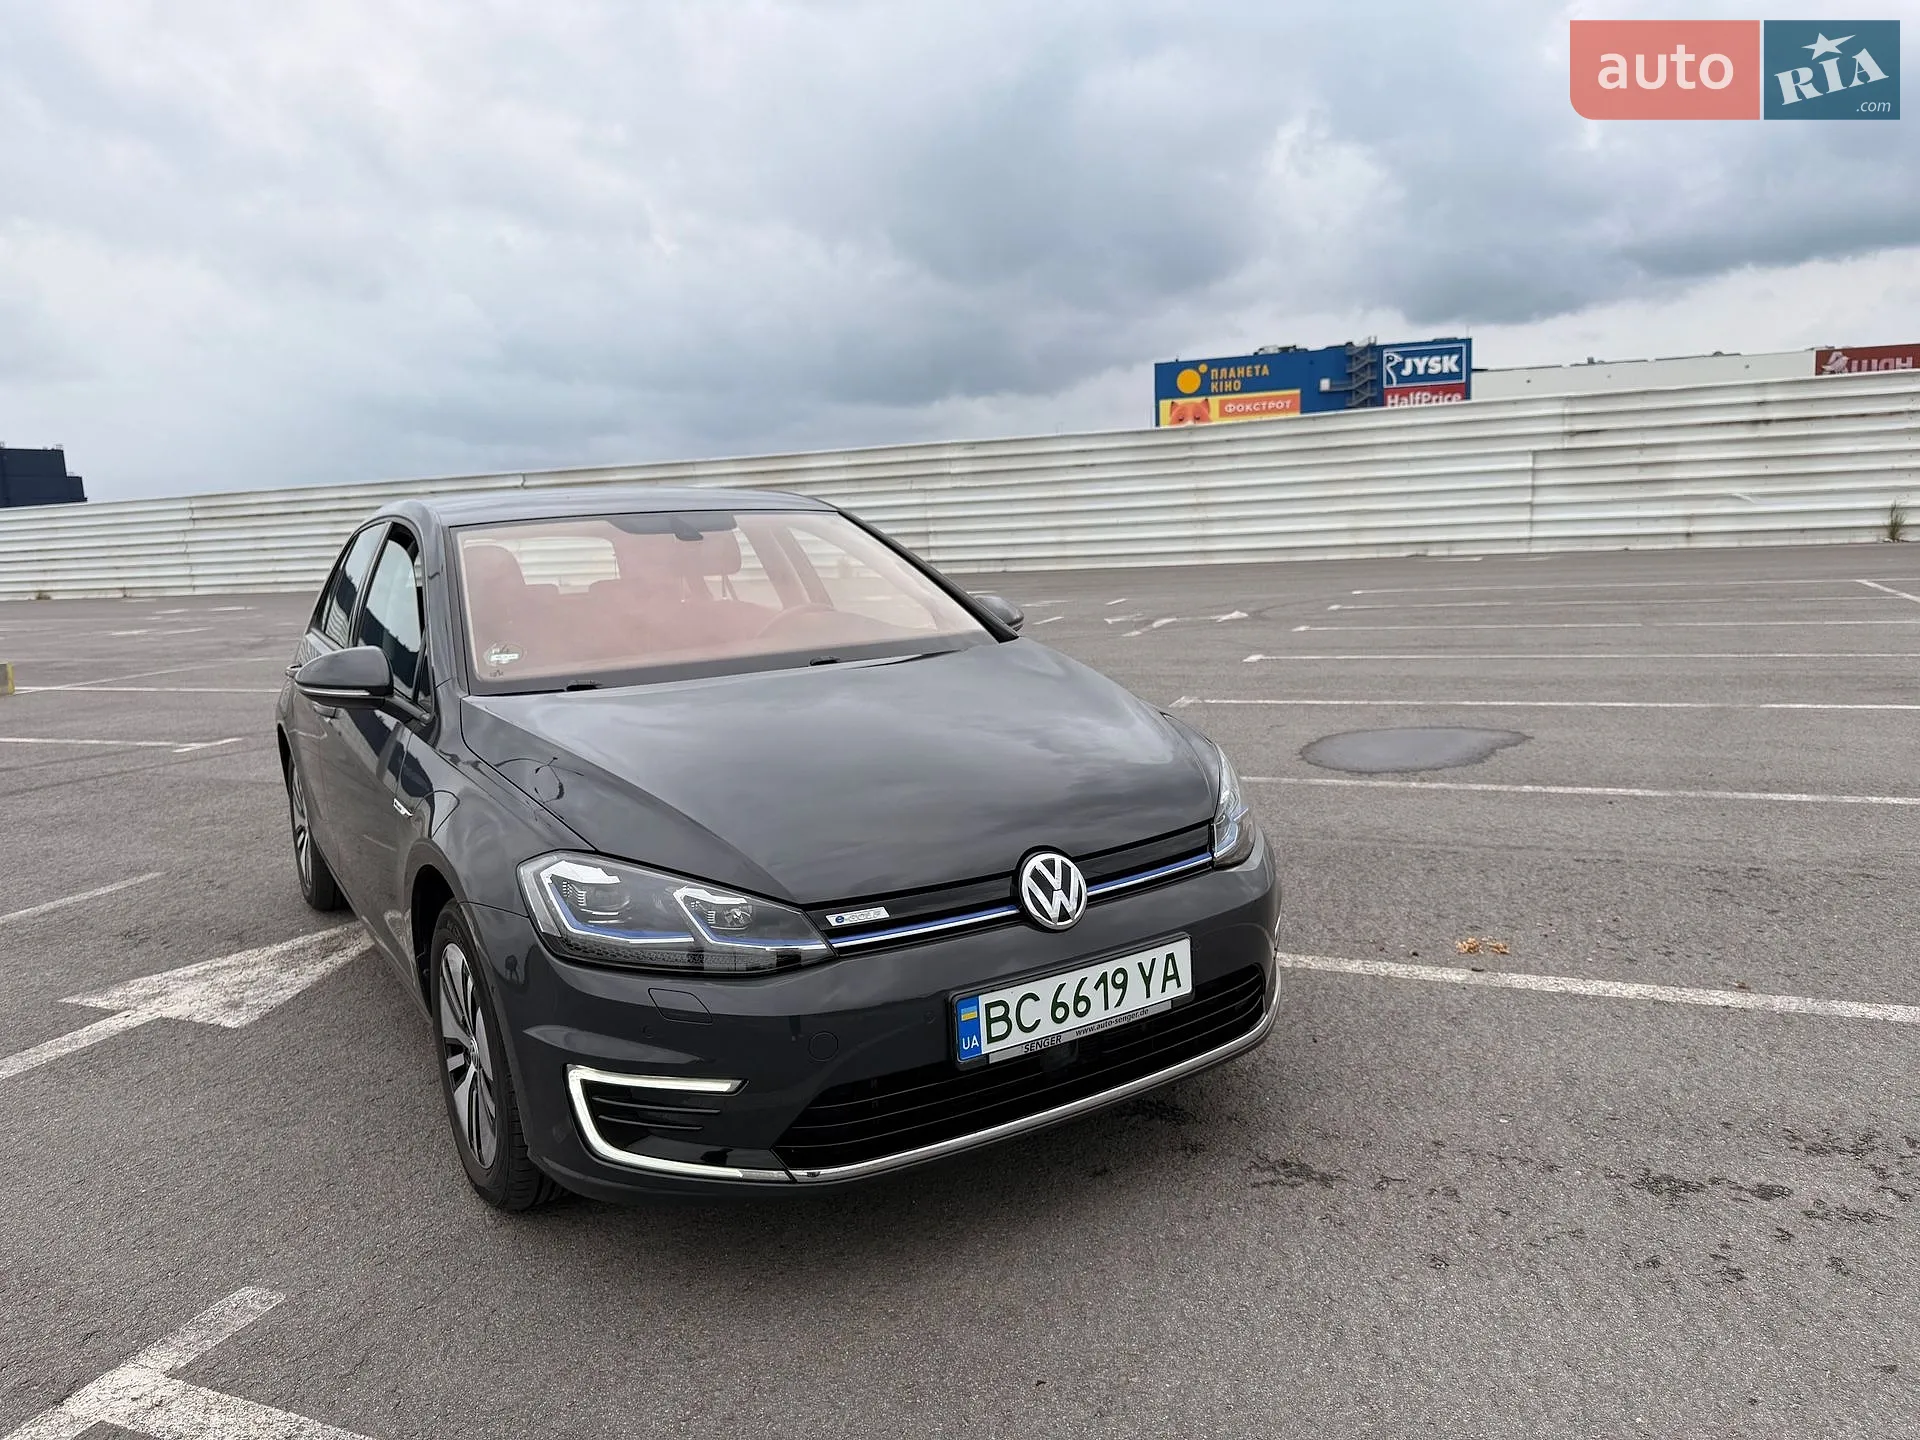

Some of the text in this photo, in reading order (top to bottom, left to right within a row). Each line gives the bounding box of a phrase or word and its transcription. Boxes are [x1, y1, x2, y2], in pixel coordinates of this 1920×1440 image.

[1210, 363, 1270, 380] ПЛАНЕТА
[1400, 353, 1460, 377] JYSK
[1210, 380, 1241, 393] КІНО
[1224, 400, 1292, 414] ФОКСТРОТ
[1386, 391, 1462, 408] HalfPrice
[984, 952, 1182, 1045] BC 6619 YA
[1023, 1008, 1150, 1053] SENGER www.auto-senger.de
[962, 1034, 980, 1050] UA
